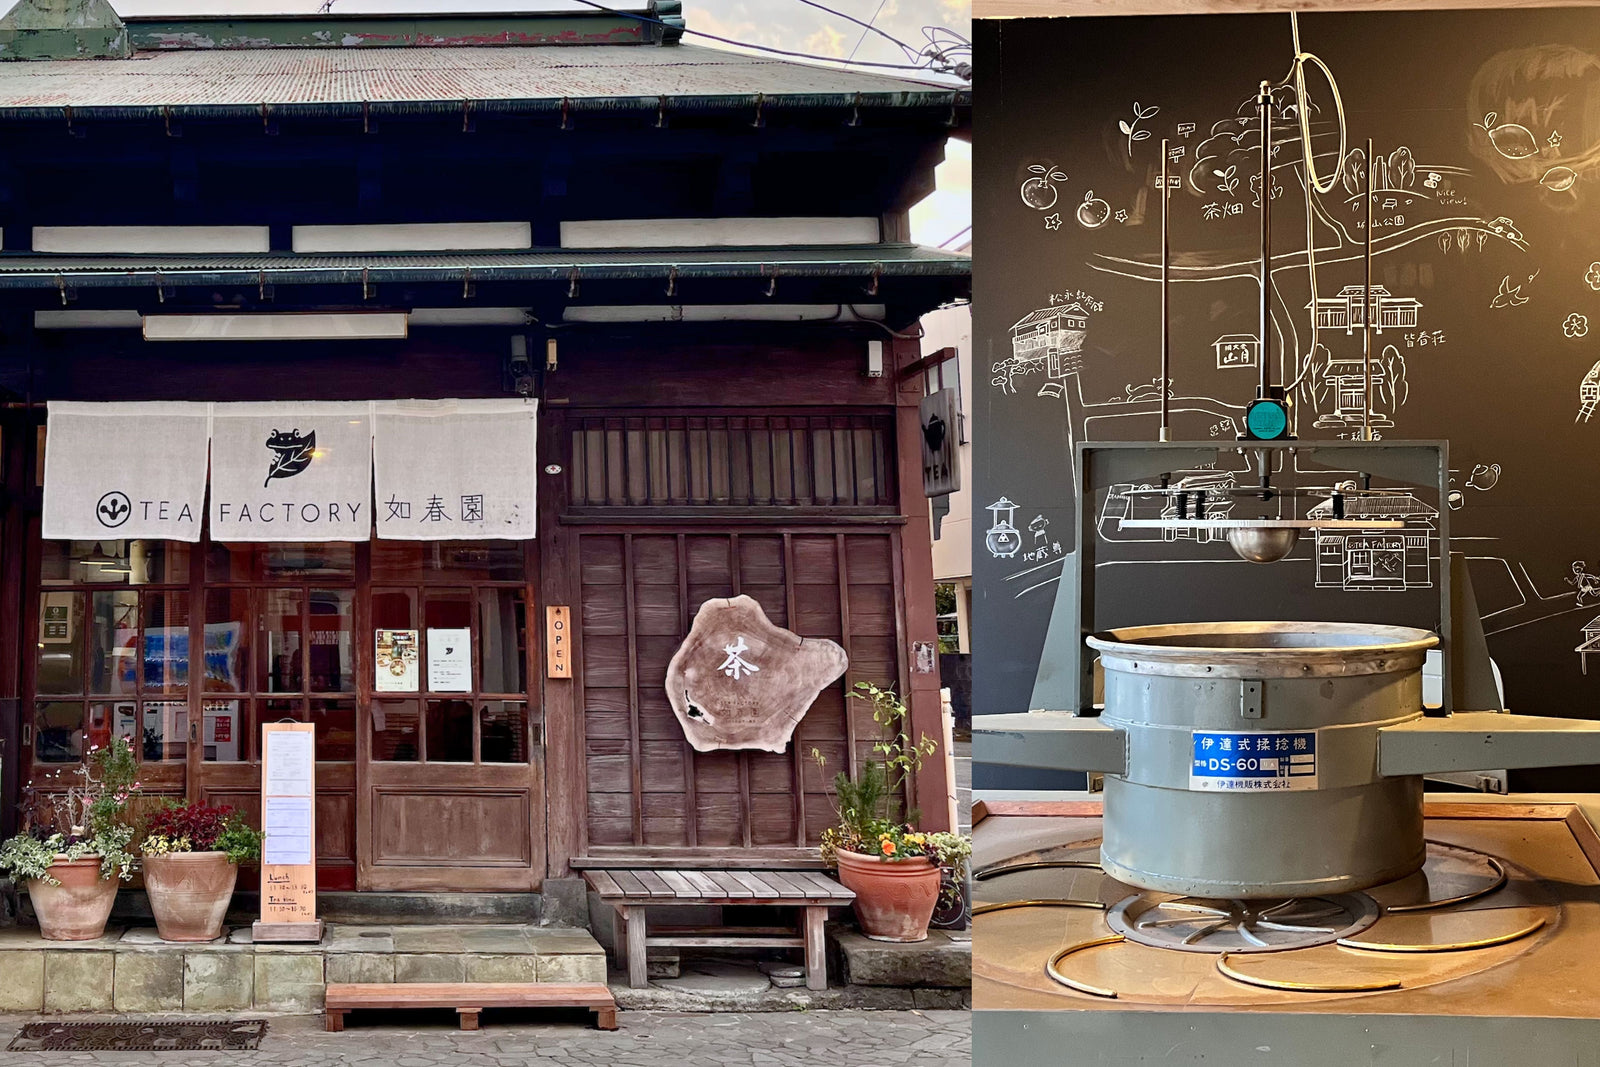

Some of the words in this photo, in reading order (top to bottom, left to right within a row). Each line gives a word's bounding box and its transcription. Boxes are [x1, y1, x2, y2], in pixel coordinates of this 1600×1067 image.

[1201, 202, 1244, 220] 茶畑
[924, 463, 949, 482] TEA
[139, 500, 193, 522] TEA
[219, 502, 361, 523] FACTORY
[384, 493, 483, 523] 如春園
[554, 620, 564, 672] OPEN
[716, 635, 760, 680] 茶
[1201, 736, 1307, 751] 伊達式揉捻機
[1209, 758, 1258, 771] DS-60
